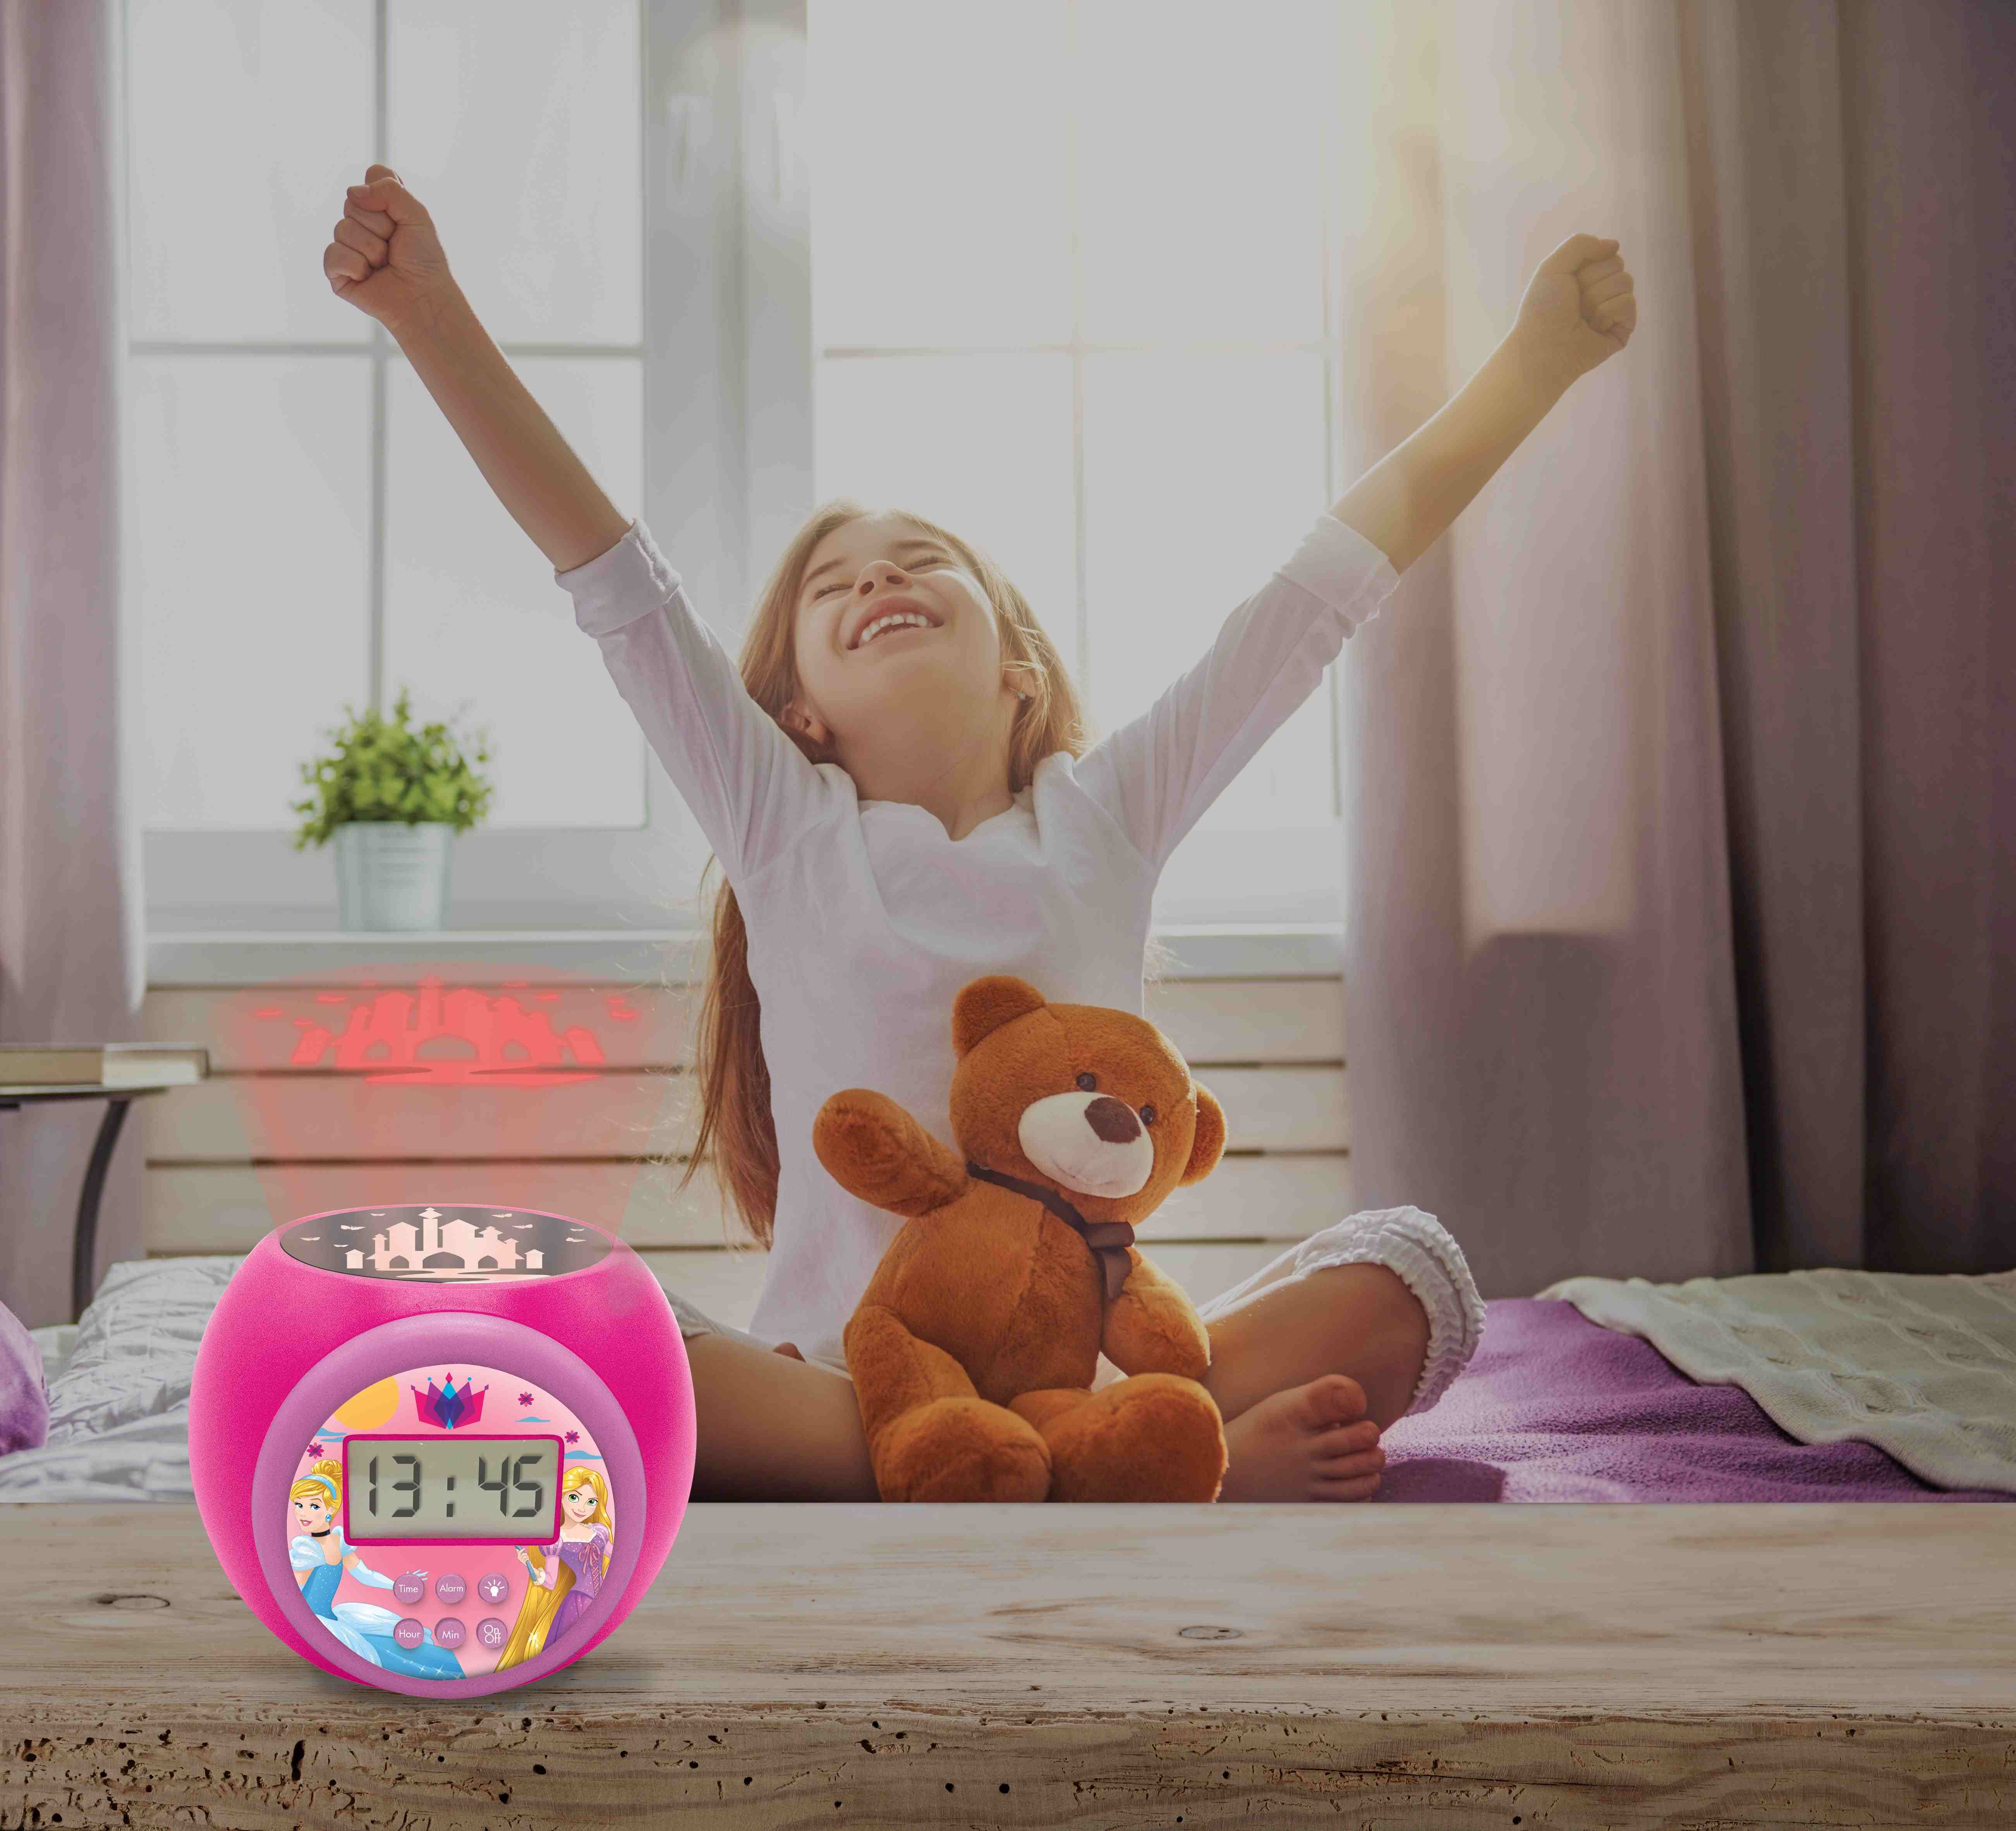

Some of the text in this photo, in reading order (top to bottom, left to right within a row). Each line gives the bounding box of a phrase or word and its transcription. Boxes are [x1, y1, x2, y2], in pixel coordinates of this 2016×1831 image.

[369, 1455, 543, 1517] 13:45
[398, 1584, 418, 1592] Time
[440, 1583, 464, 1592] Alarm
[399, 1629, 421, 1638] Hour
[484, 1625, 499, 1634] On
[442, 1630, 459, 1639] Min
[484, 1632, 501, 1644] Off
